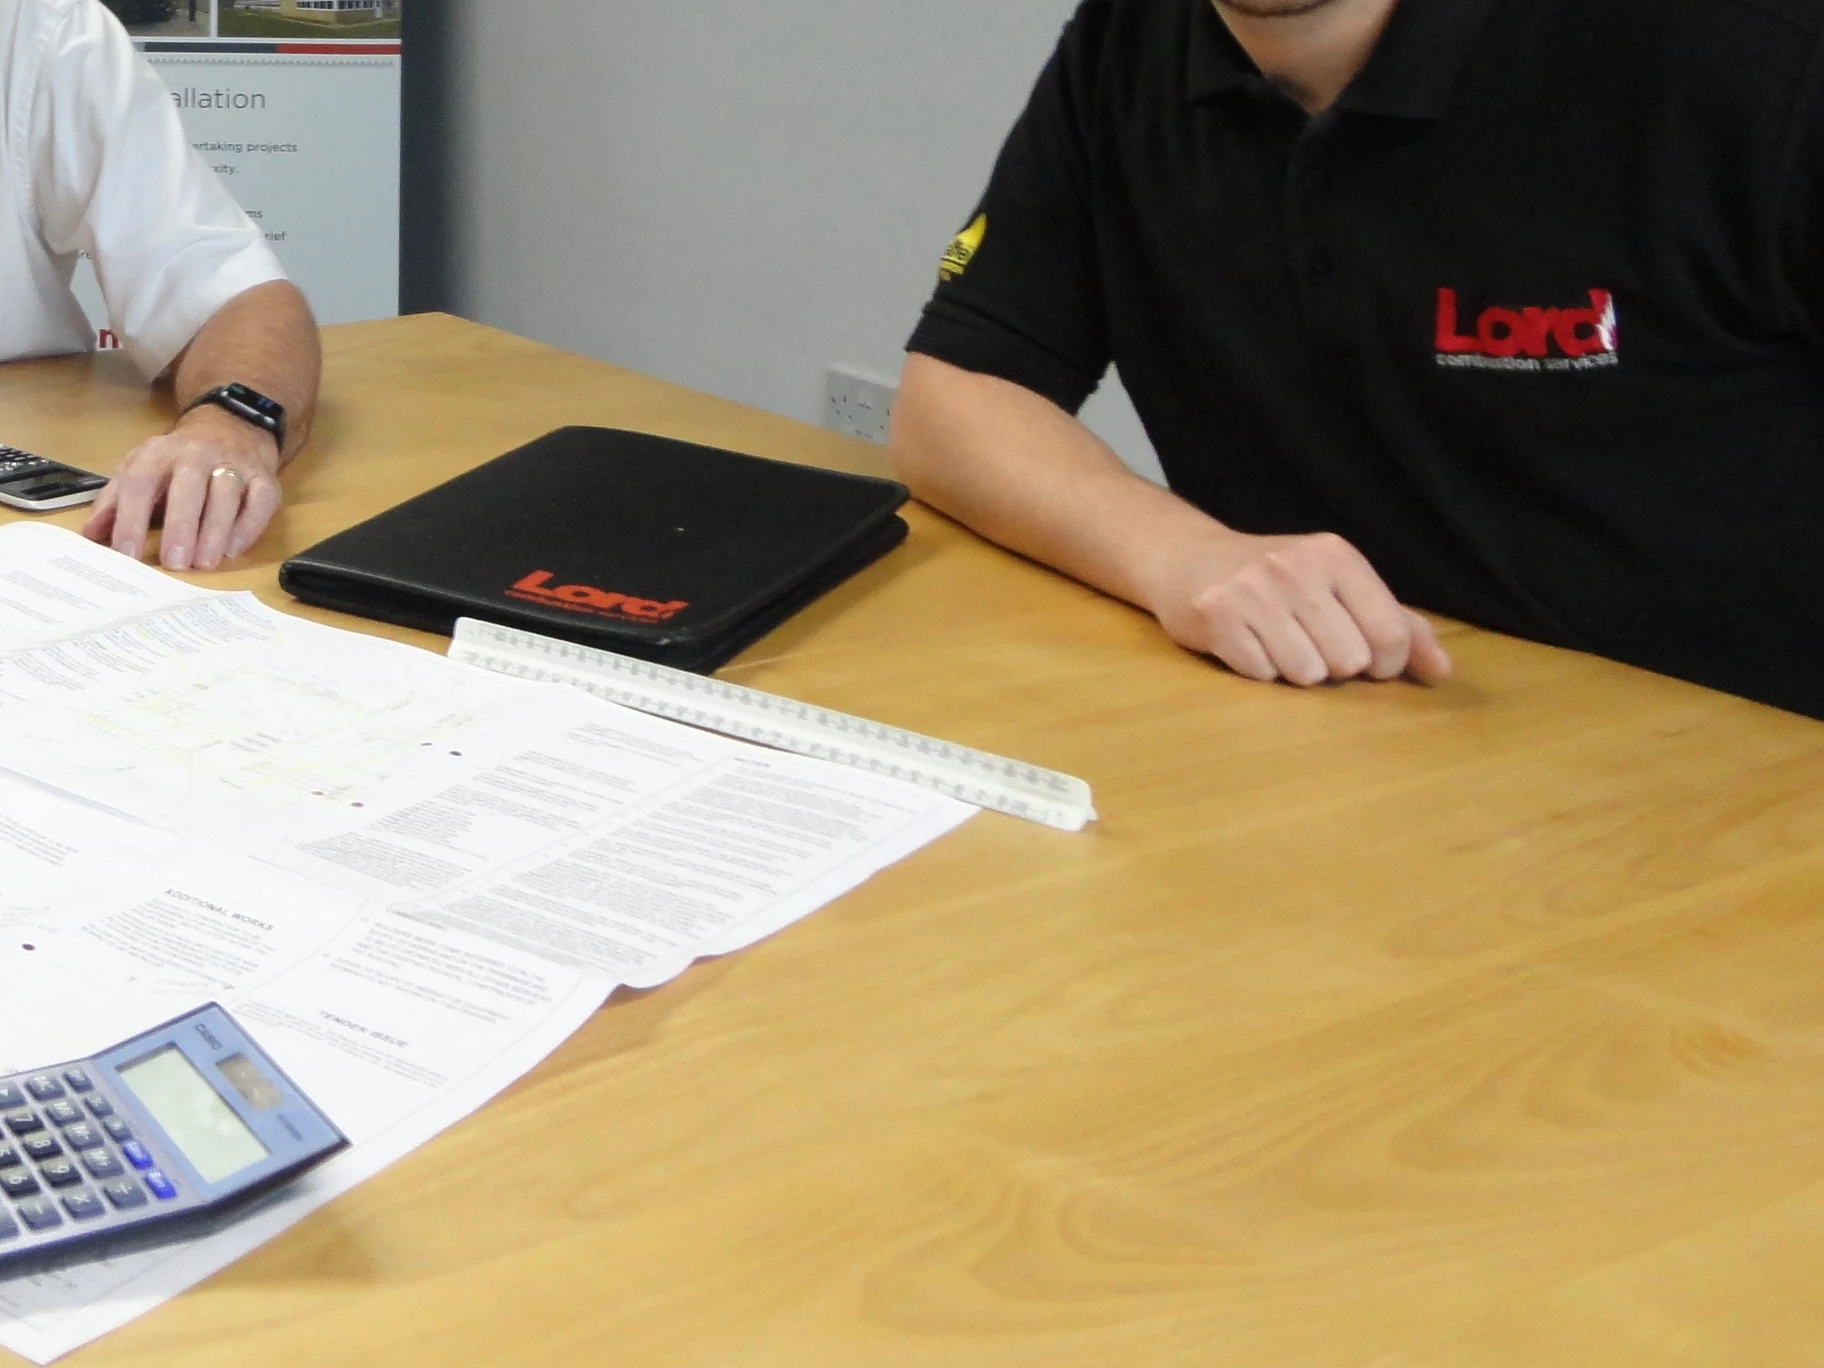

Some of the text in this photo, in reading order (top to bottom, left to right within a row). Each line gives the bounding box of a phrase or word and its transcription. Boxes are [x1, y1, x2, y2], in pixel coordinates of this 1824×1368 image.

[247, 141, 298, 154] projects
[1435, 288, 1617, 356] Lord
[512, 569, 690, 618] Lord
[164, 888, 275, 932] ADDITIONAL WORKS
[319, 1009, 369, 1033] TENDER
[14, 1112, 70, 1175] 7 8 9
